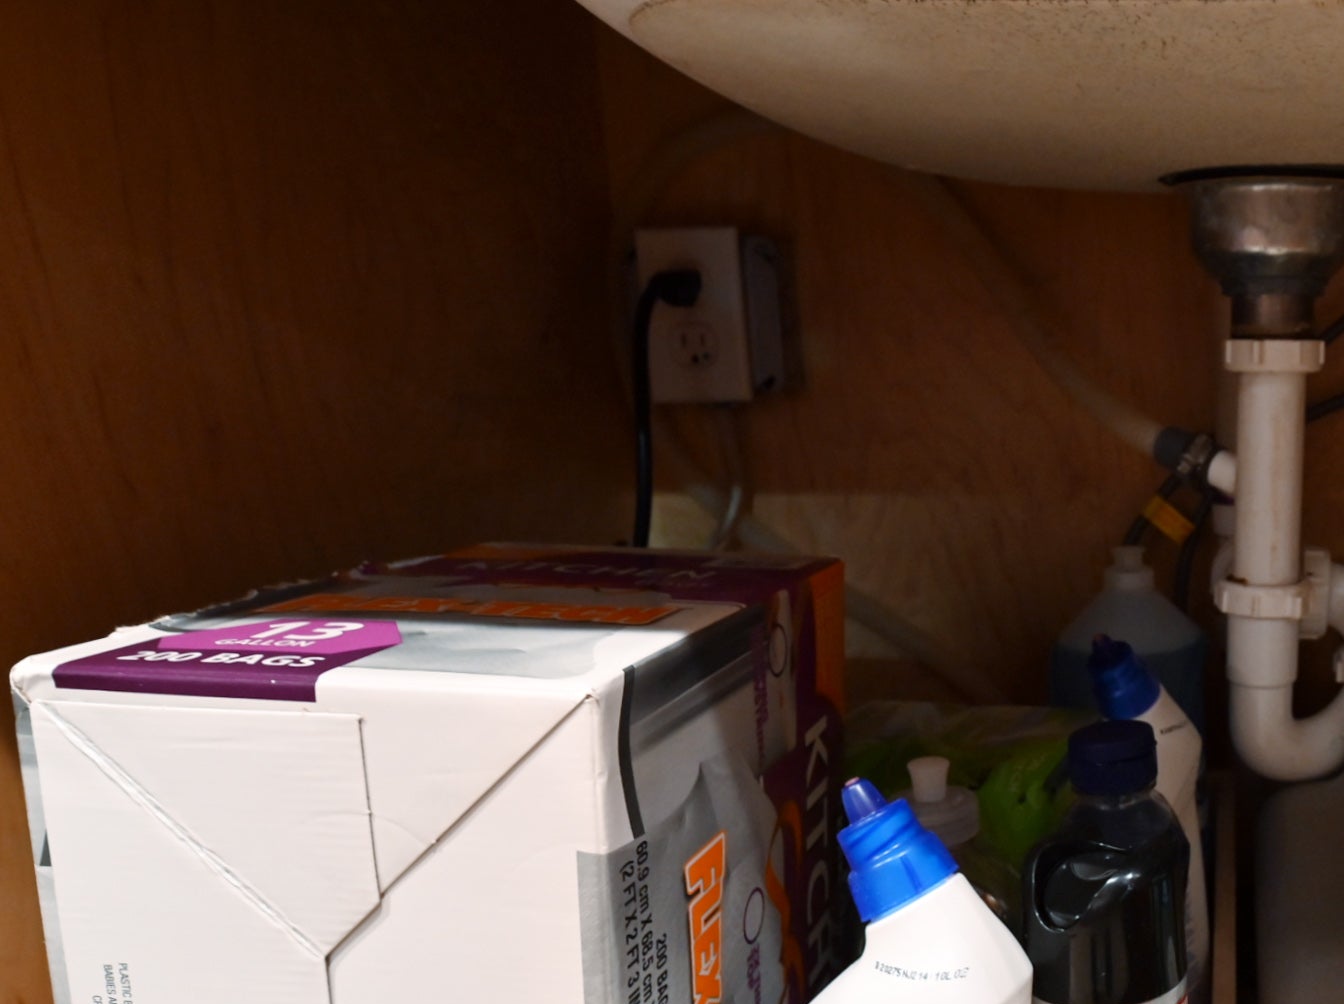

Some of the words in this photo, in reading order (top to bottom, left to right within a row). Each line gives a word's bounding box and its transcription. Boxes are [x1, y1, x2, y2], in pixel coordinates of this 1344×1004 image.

[215, 639, 316, 648] GALLON
[250, 620, 365, 641] 13
[117, 650, 203, 662] 200
[202, 653, 326, 667] BAGS
[636, 840, 650, 881] 60.9
[803, 714, 829, 988] KITCH
[622, 881, 636, 907] FT
[639, 884, 650, 910] cm
[625, 909, 637, 928] X
[640, 913, 653, 929] X
[626, 928, 639, 946] 2
[641, 930, 654, 971] 68.5
[656, 932, 669, 969] 200
[642, 973, 653, 1003] cm
